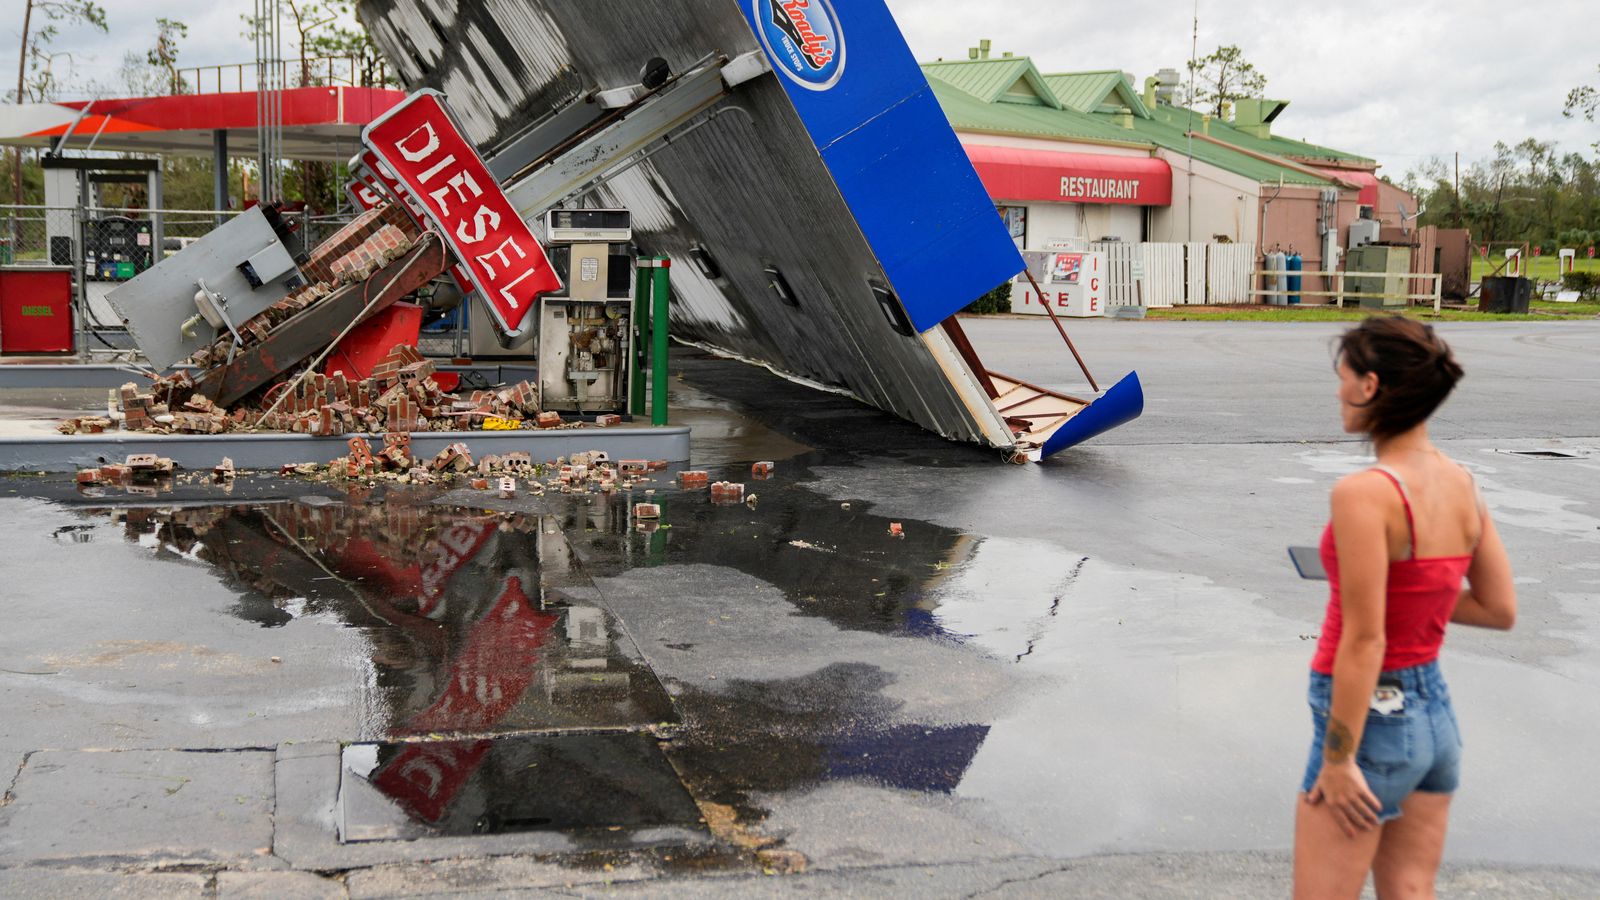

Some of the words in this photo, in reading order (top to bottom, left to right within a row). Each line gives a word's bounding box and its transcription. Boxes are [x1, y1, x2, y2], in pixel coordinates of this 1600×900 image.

[781, 35, 795, 55] TRUCK
[790, 53, 804, 72] STOPS
[1060, 176, 1140, 200] RESTAURANT
[394, 120, 535, 309] DIESEL
[1090, 257, 1099, 312] ICE
[21, 305, 55, 316] DIESEL
